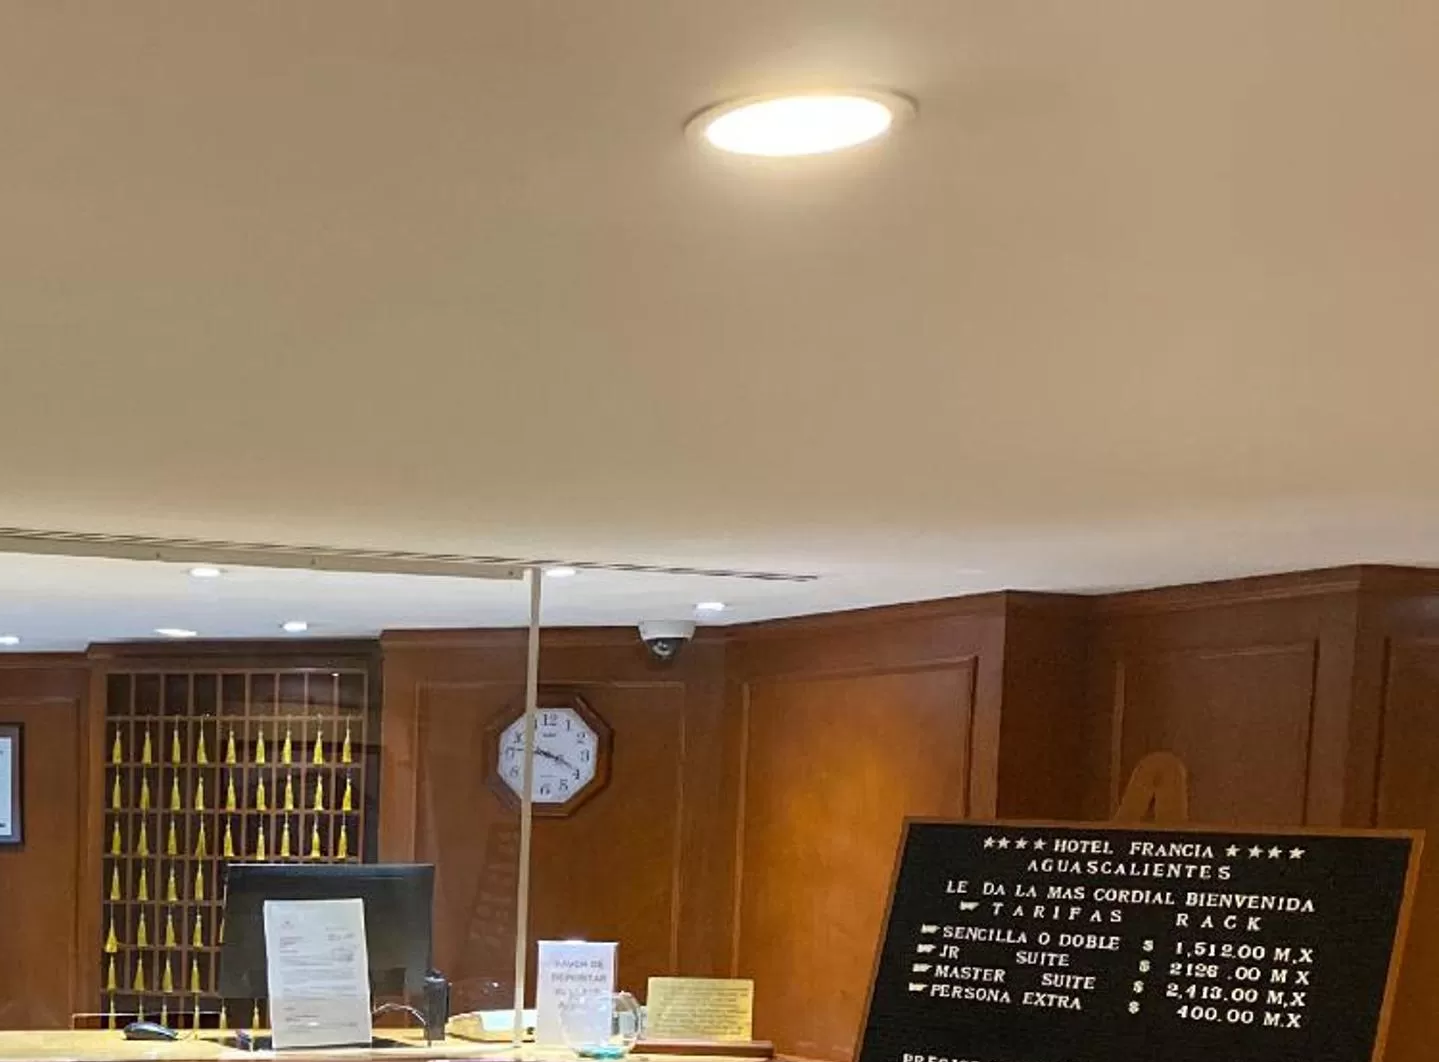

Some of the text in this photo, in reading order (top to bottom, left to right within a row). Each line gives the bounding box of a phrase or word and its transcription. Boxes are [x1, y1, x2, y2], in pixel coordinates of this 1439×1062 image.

[1054, 839, 1214, 859] HOTEL FRANCIA
[1027, 858, 1231, 880] AGUASCALIENTES
[945, 880, 1315, 912] LE DA LA MAS CORDIAL BIENVENIDA
[942, 926, 1028, 944] SENCILLA
[1038, 932, 1050, 945] O
[1059, 934, 1121, 950] DOBLE
[939, 945, 960, 959] JR
[1016, 951, 1070, 967] SUITE
[934, 965, 1006, 983] MASTER
[1041, 973, 1096, 990] SUITE
[930, 984, 1011, 1004] PERSONA
[1022, 991, 1082, 1011] EXTRA
